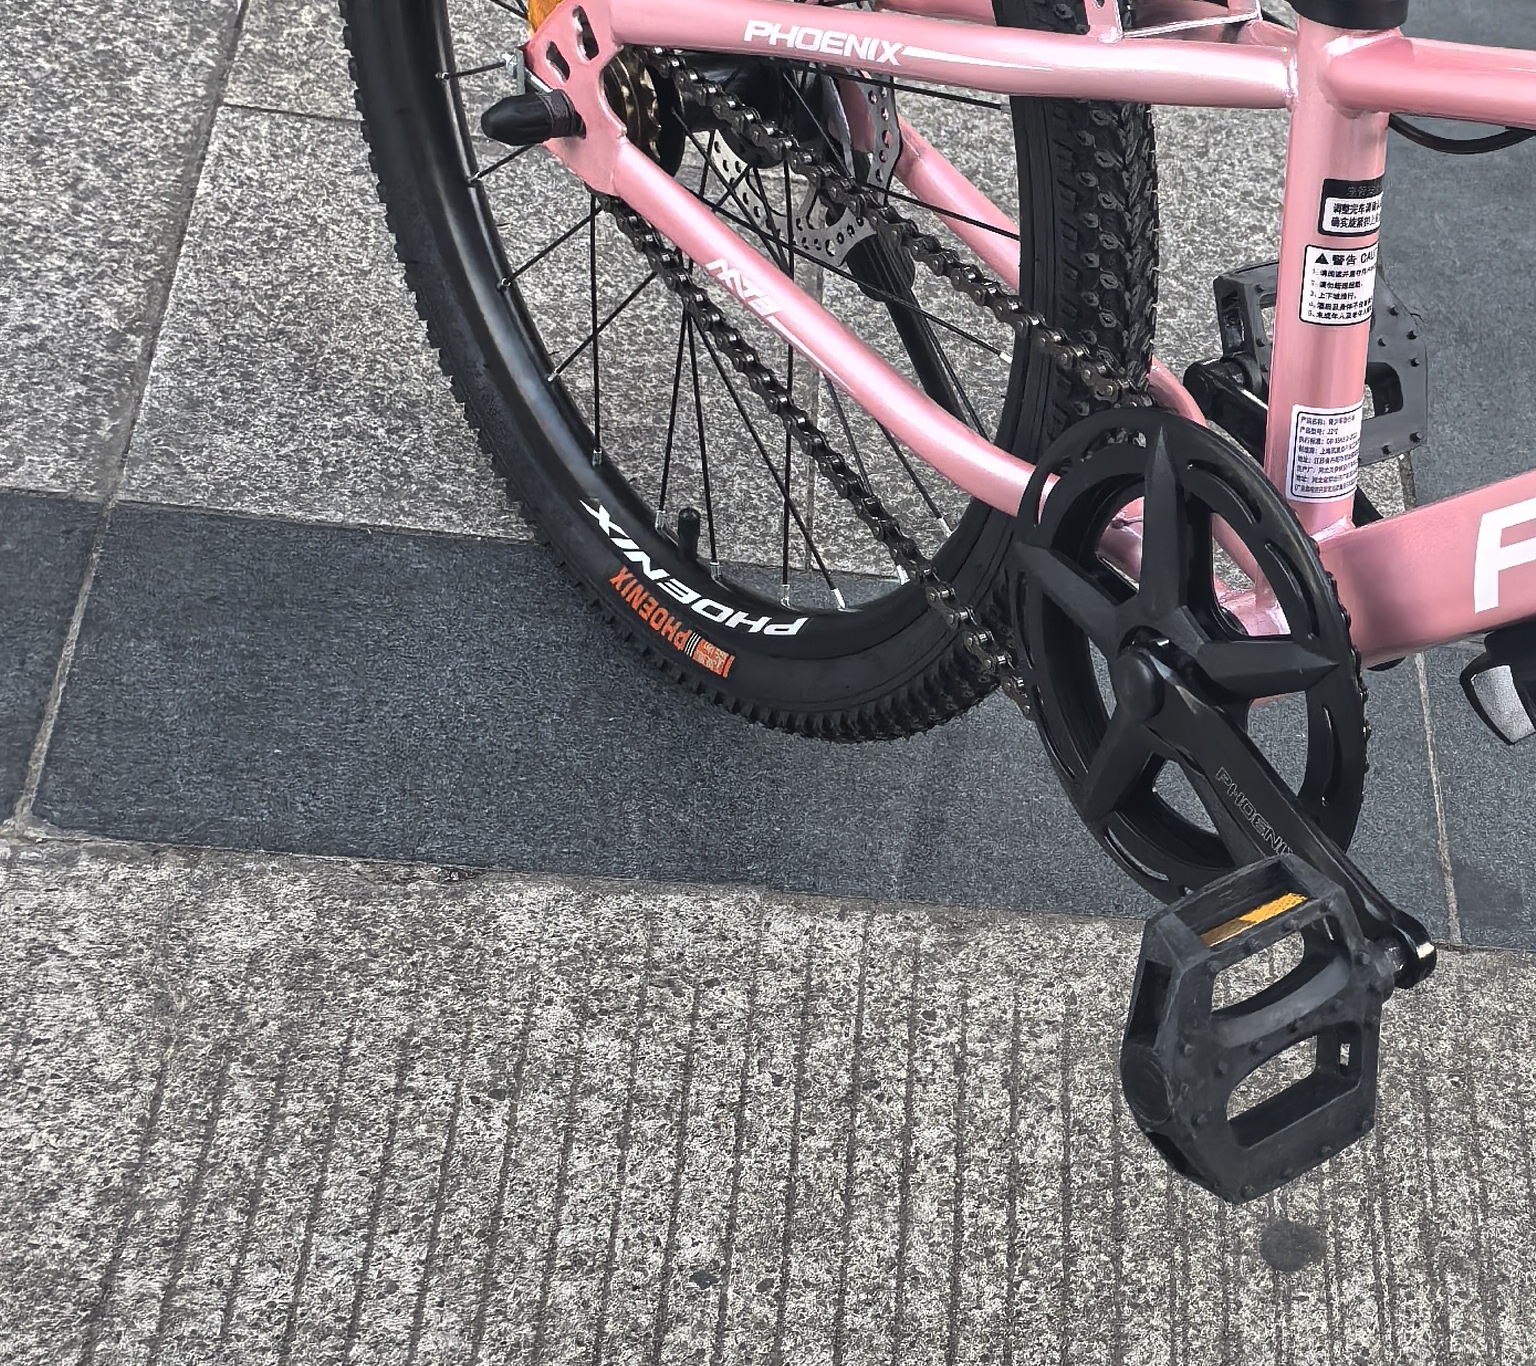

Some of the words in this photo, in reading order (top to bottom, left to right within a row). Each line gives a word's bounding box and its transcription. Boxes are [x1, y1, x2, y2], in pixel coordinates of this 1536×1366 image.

[744, 19, 902, 66] PHOENIX
[1332, 254, 1357, 266] 警告
[579, 499, 809, 635] PHOENIX
[609, 565, 692, 651] PHOENIX
